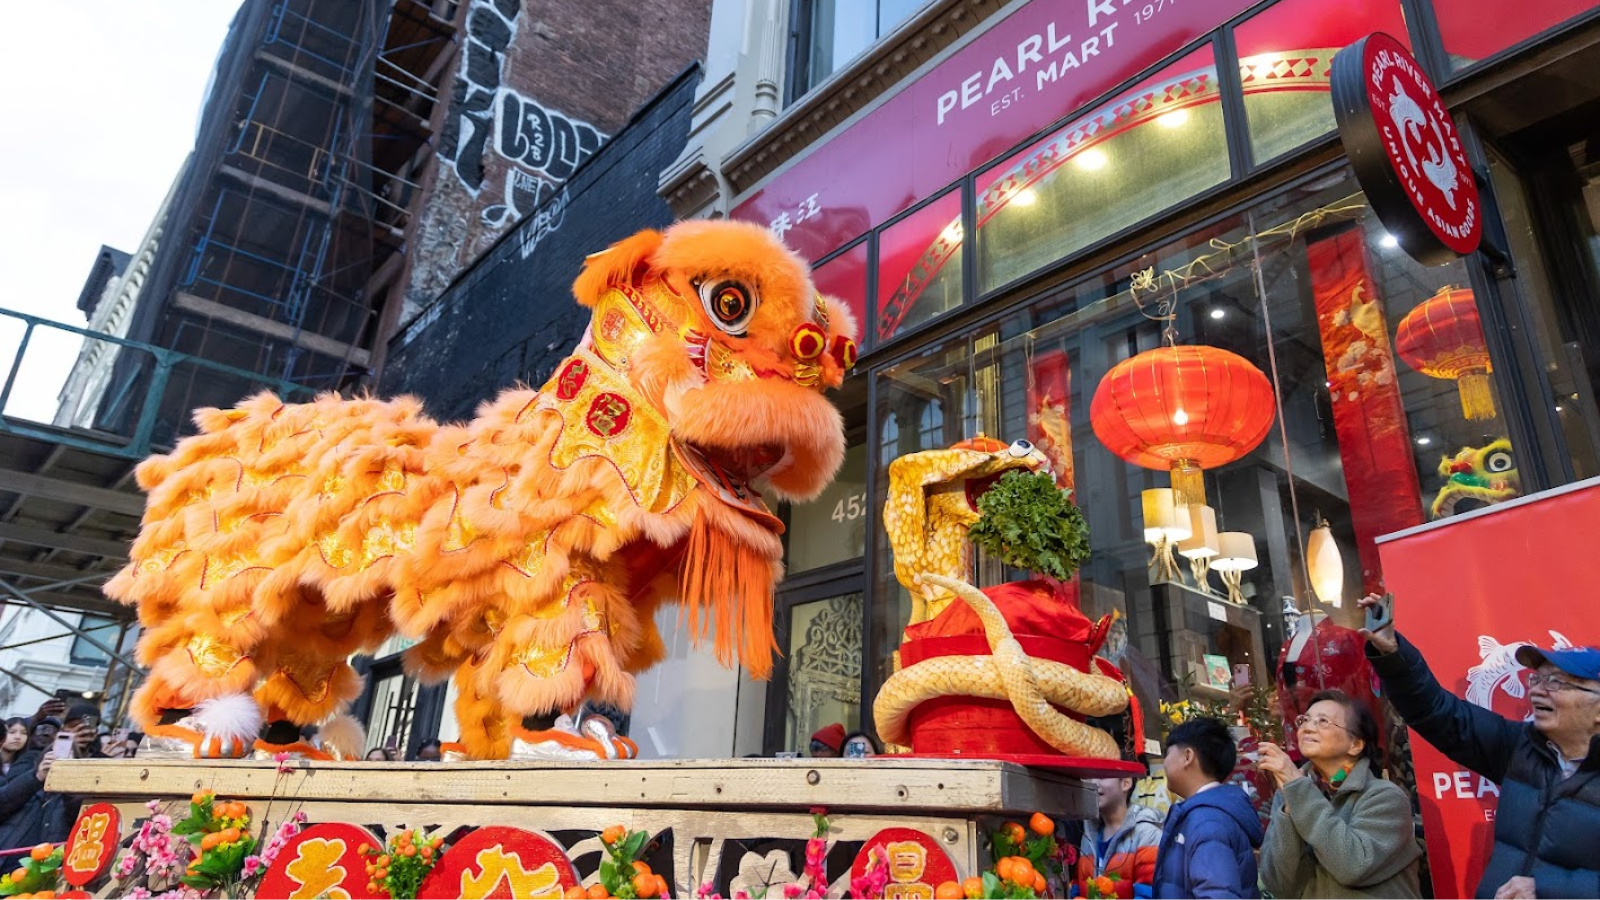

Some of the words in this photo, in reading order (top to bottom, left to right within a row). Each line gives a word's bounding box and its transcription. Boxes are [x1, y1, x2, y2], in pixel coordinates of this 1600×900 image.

[937, 22, 1071, 126] PEARL
[991, 87, 1025, 116] EST.
[1036, 21, 1118, 91] MART
[1372, 49, 1395, 92] PEARL
[1392, 51, 1431, 100] RIVER
[1434, 101, 1466, 167] MART
[1383, 126, 1424, 206] UNIQUE
[1427, 207, 1460, 239] ASIAN
[1459, 198, 1475, 238] GOODS
